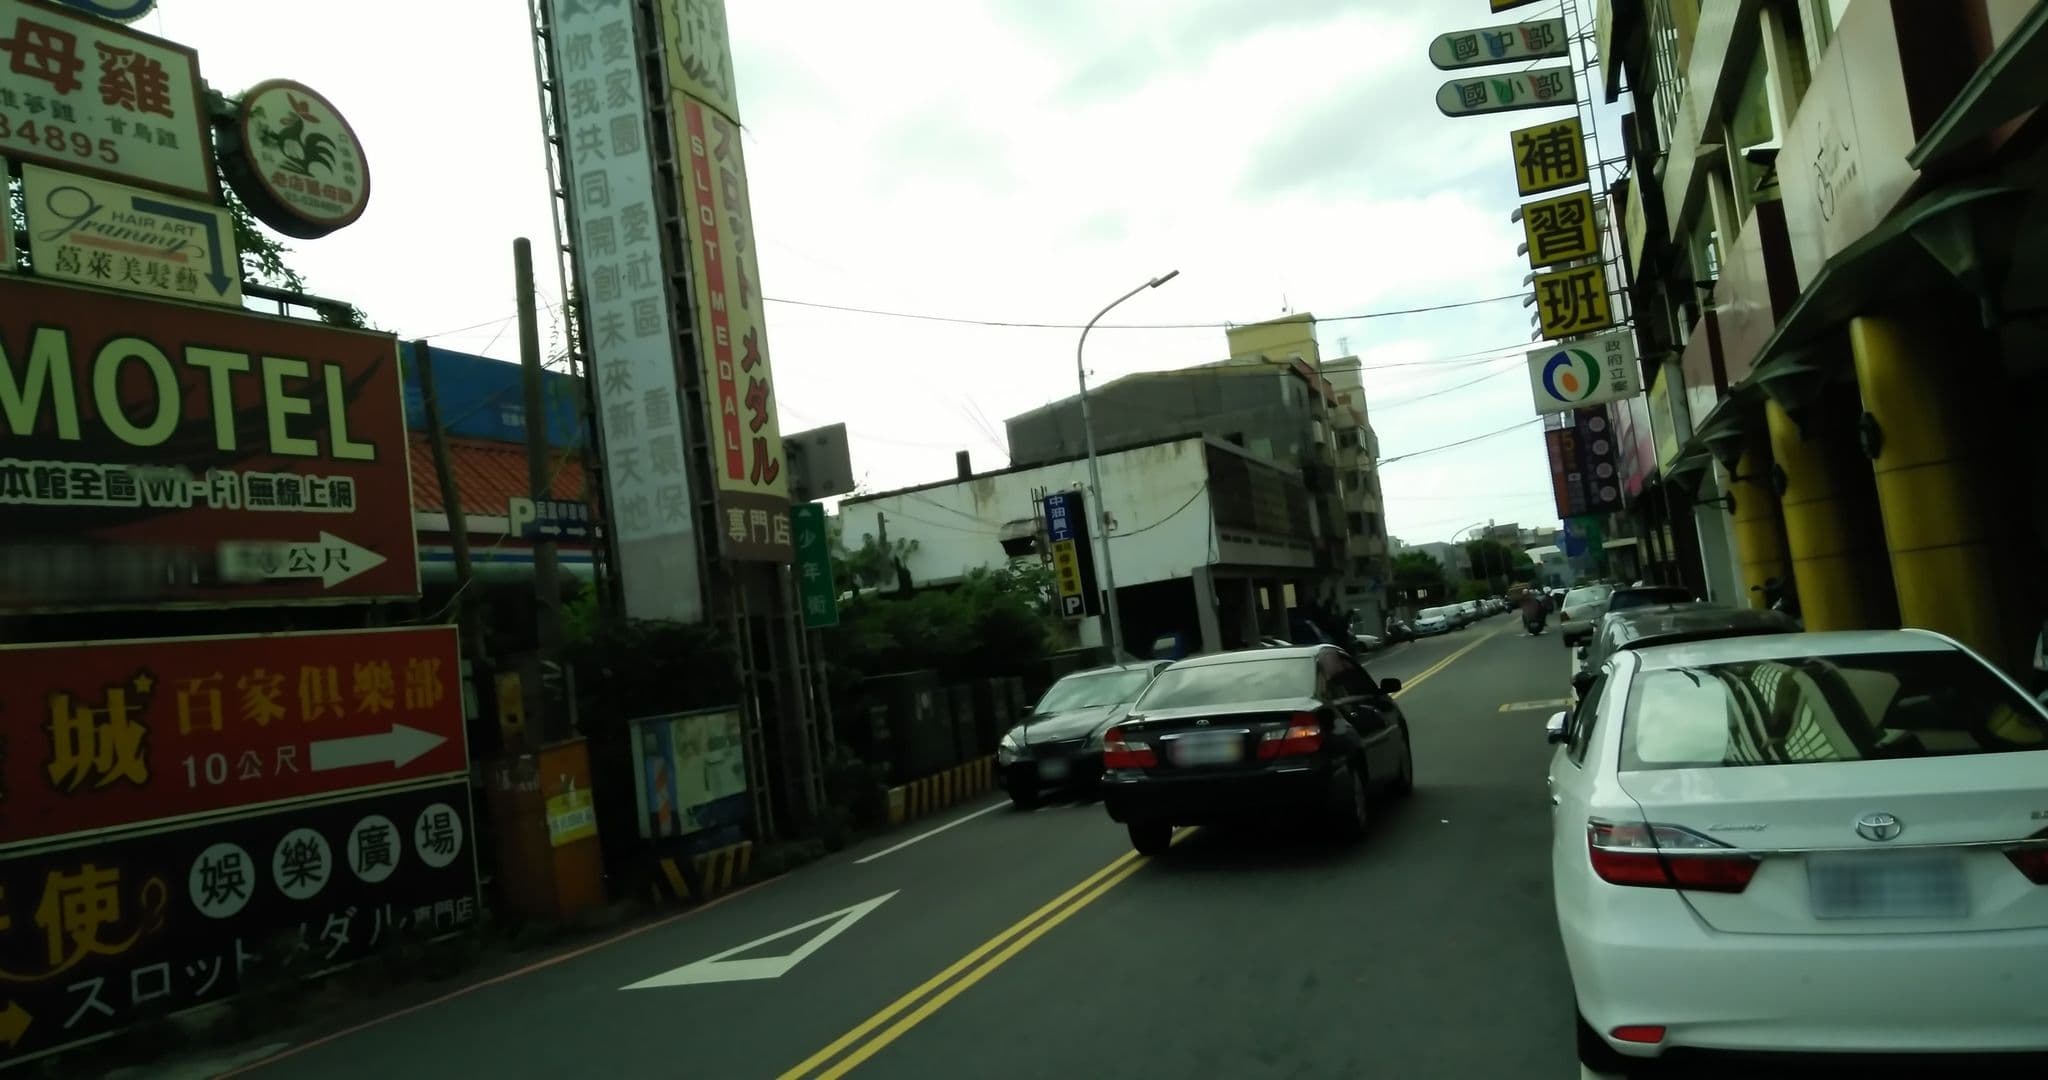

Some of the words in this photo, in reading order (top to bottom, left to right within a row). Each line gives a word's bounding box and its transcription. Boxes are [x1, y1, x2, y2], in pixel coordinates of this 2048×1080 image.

[1454, 23, 1555, 61] 國中部
[1462, 72, 1564, 107] 國小部
[111, 210, 155, 229] HAIR
[162, 221, 199, 236] ART
[1517, 125, 1605, 330] 補習班
[55, 245, 200, 295] 葛萊美髮藝
[565, 33, 650, 536] 你我共同開創未來新天地
[691, 136, 716, 261] SLOT
[711, 291, 738, 450] MEDAL
[0, 327, 375, 461] MOTEL
[740, 325, 780, 486] メダル
[509, 496, 537, 538] P
[726, 507, 791, 546] 專門店
[1049, 495, 1074, 541] 中油員工
[1066, 597, 1081, 615] P
[175, 656, 445, 736] 百家俱樂部
[47, 687, 149, 788] 城
[198, 811, 456, 908] 娛樂廣場
[0, 863, 121, 967] 使
